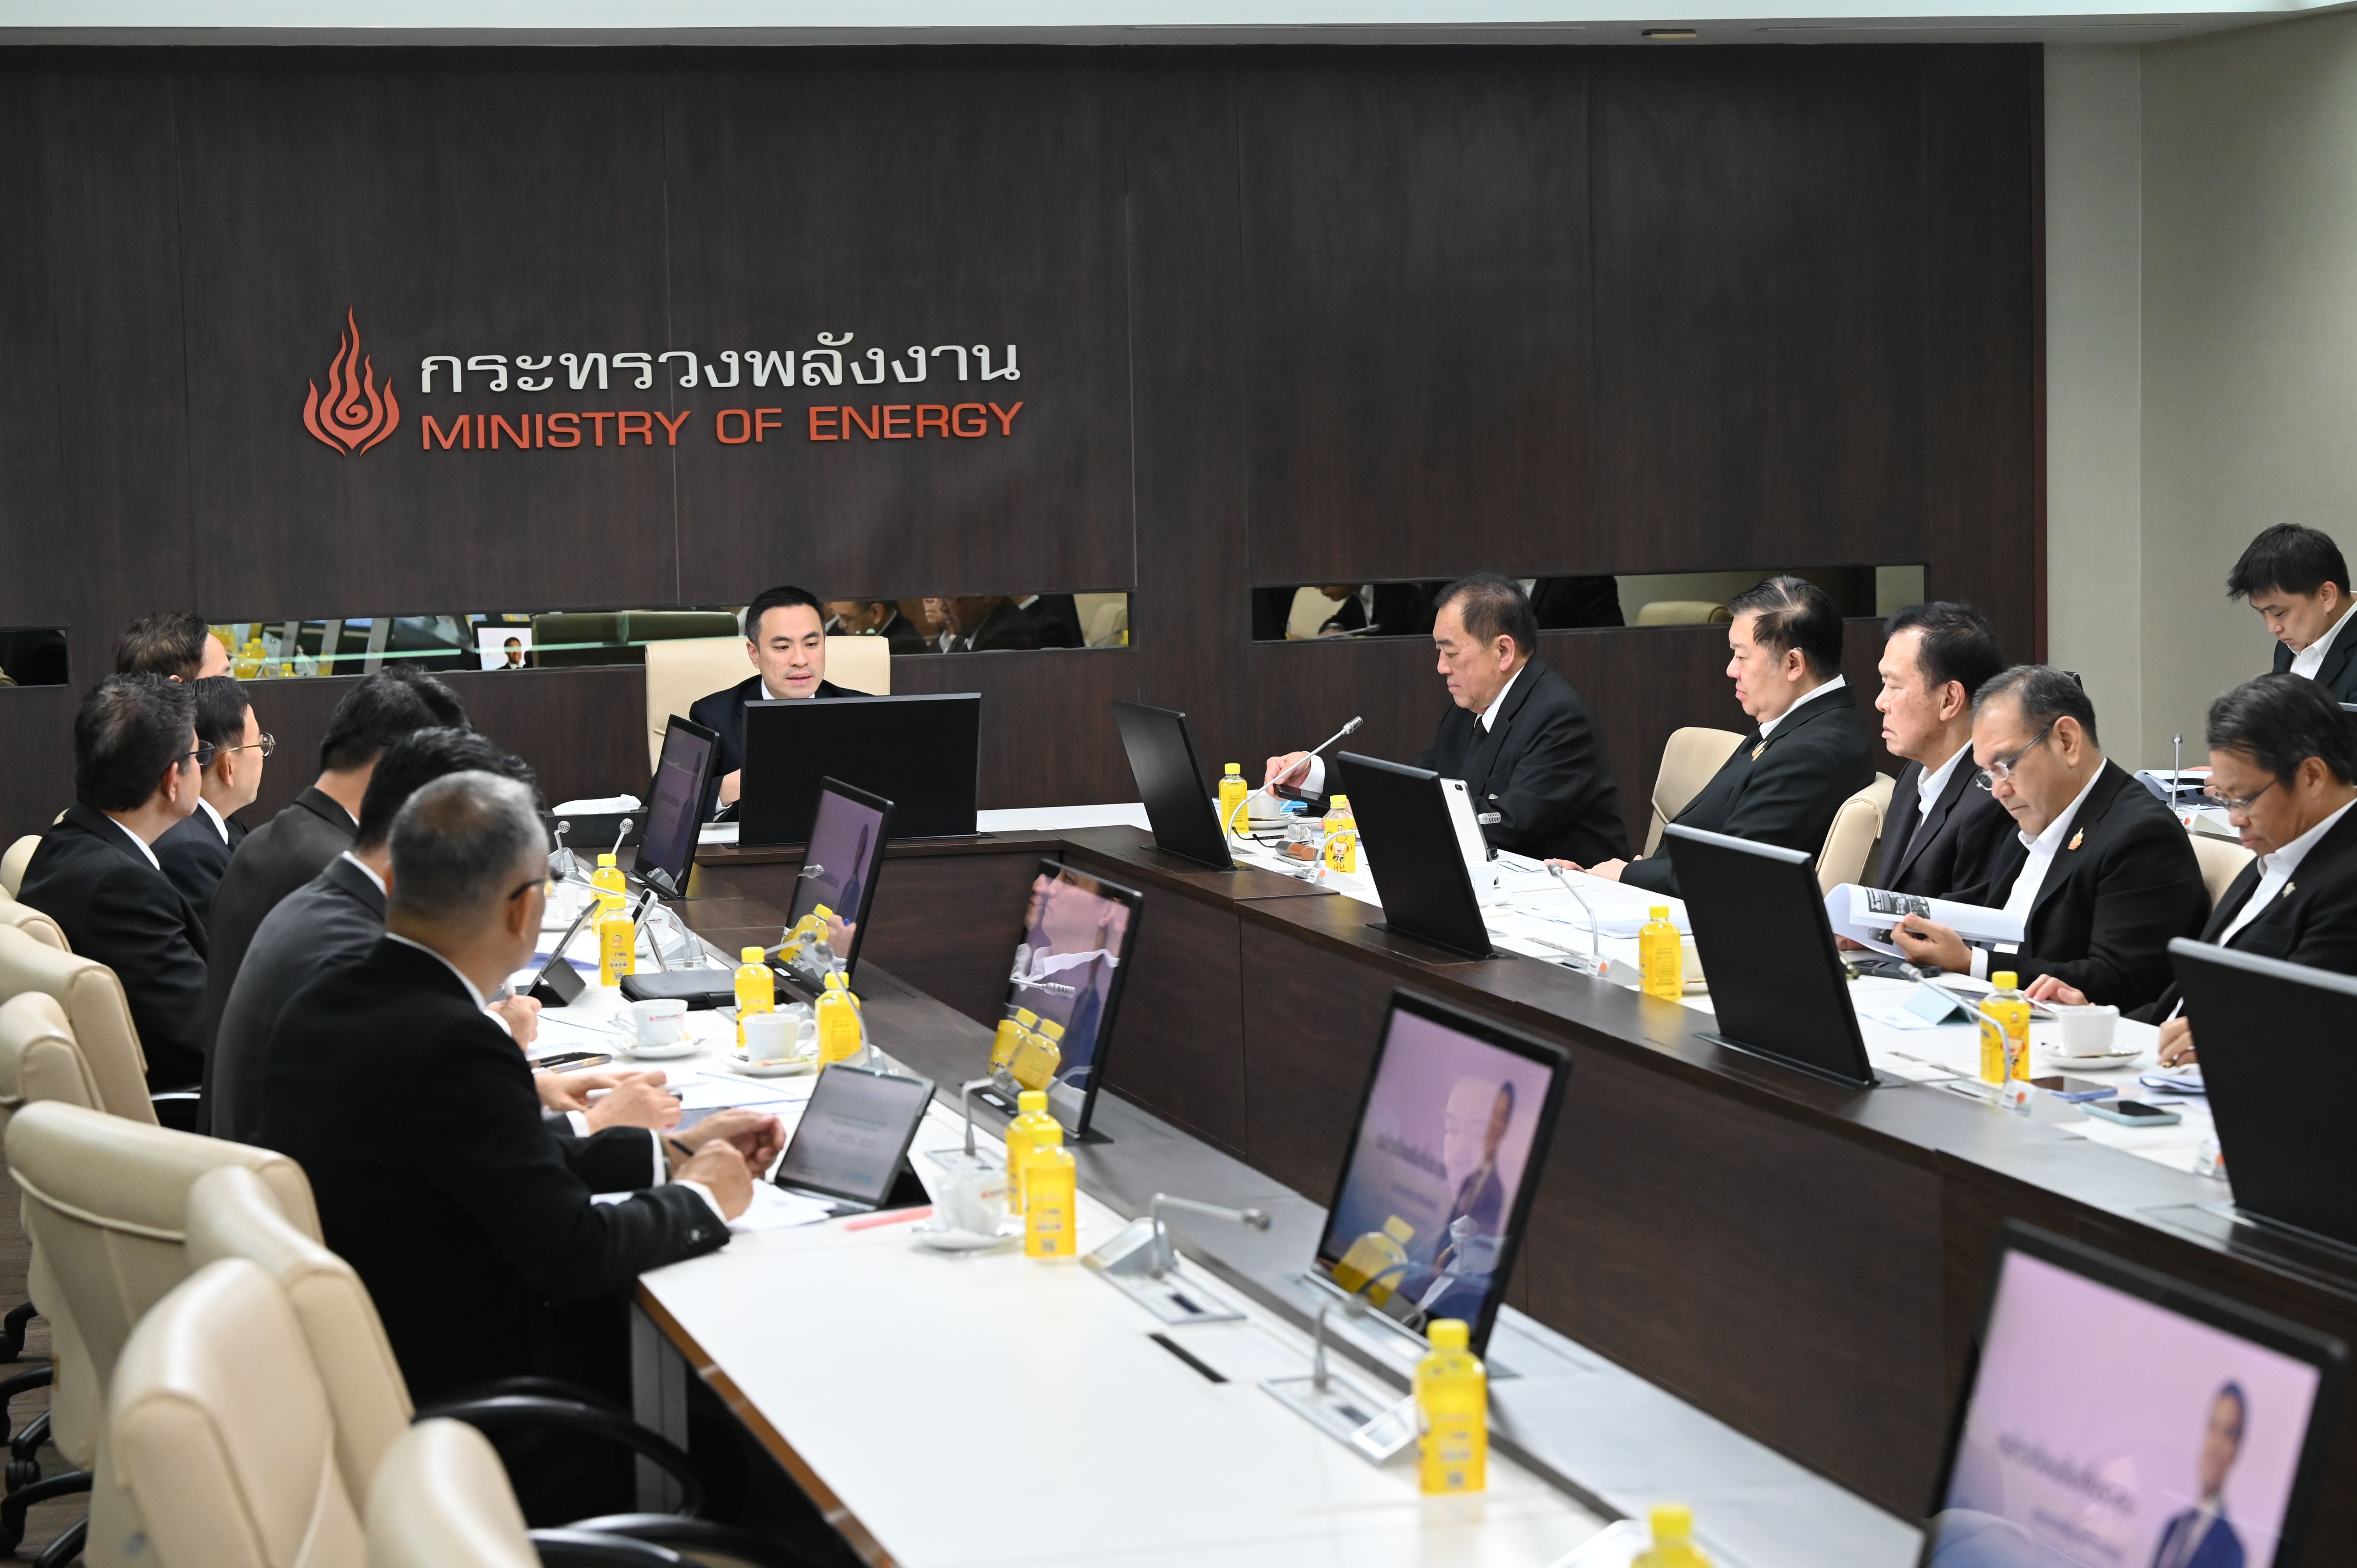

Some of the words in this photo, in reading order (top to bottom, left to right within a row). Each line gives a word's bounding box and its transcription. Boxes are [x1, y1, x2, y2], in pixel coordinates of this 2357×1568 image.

[421, 331, 1021, 393] กระทรวงพลังงาน
[422, 411, 691, 450] MINISTRY
[716, 408, 782, 444] OF
[809, 401, 1023, 440] ENERGY
